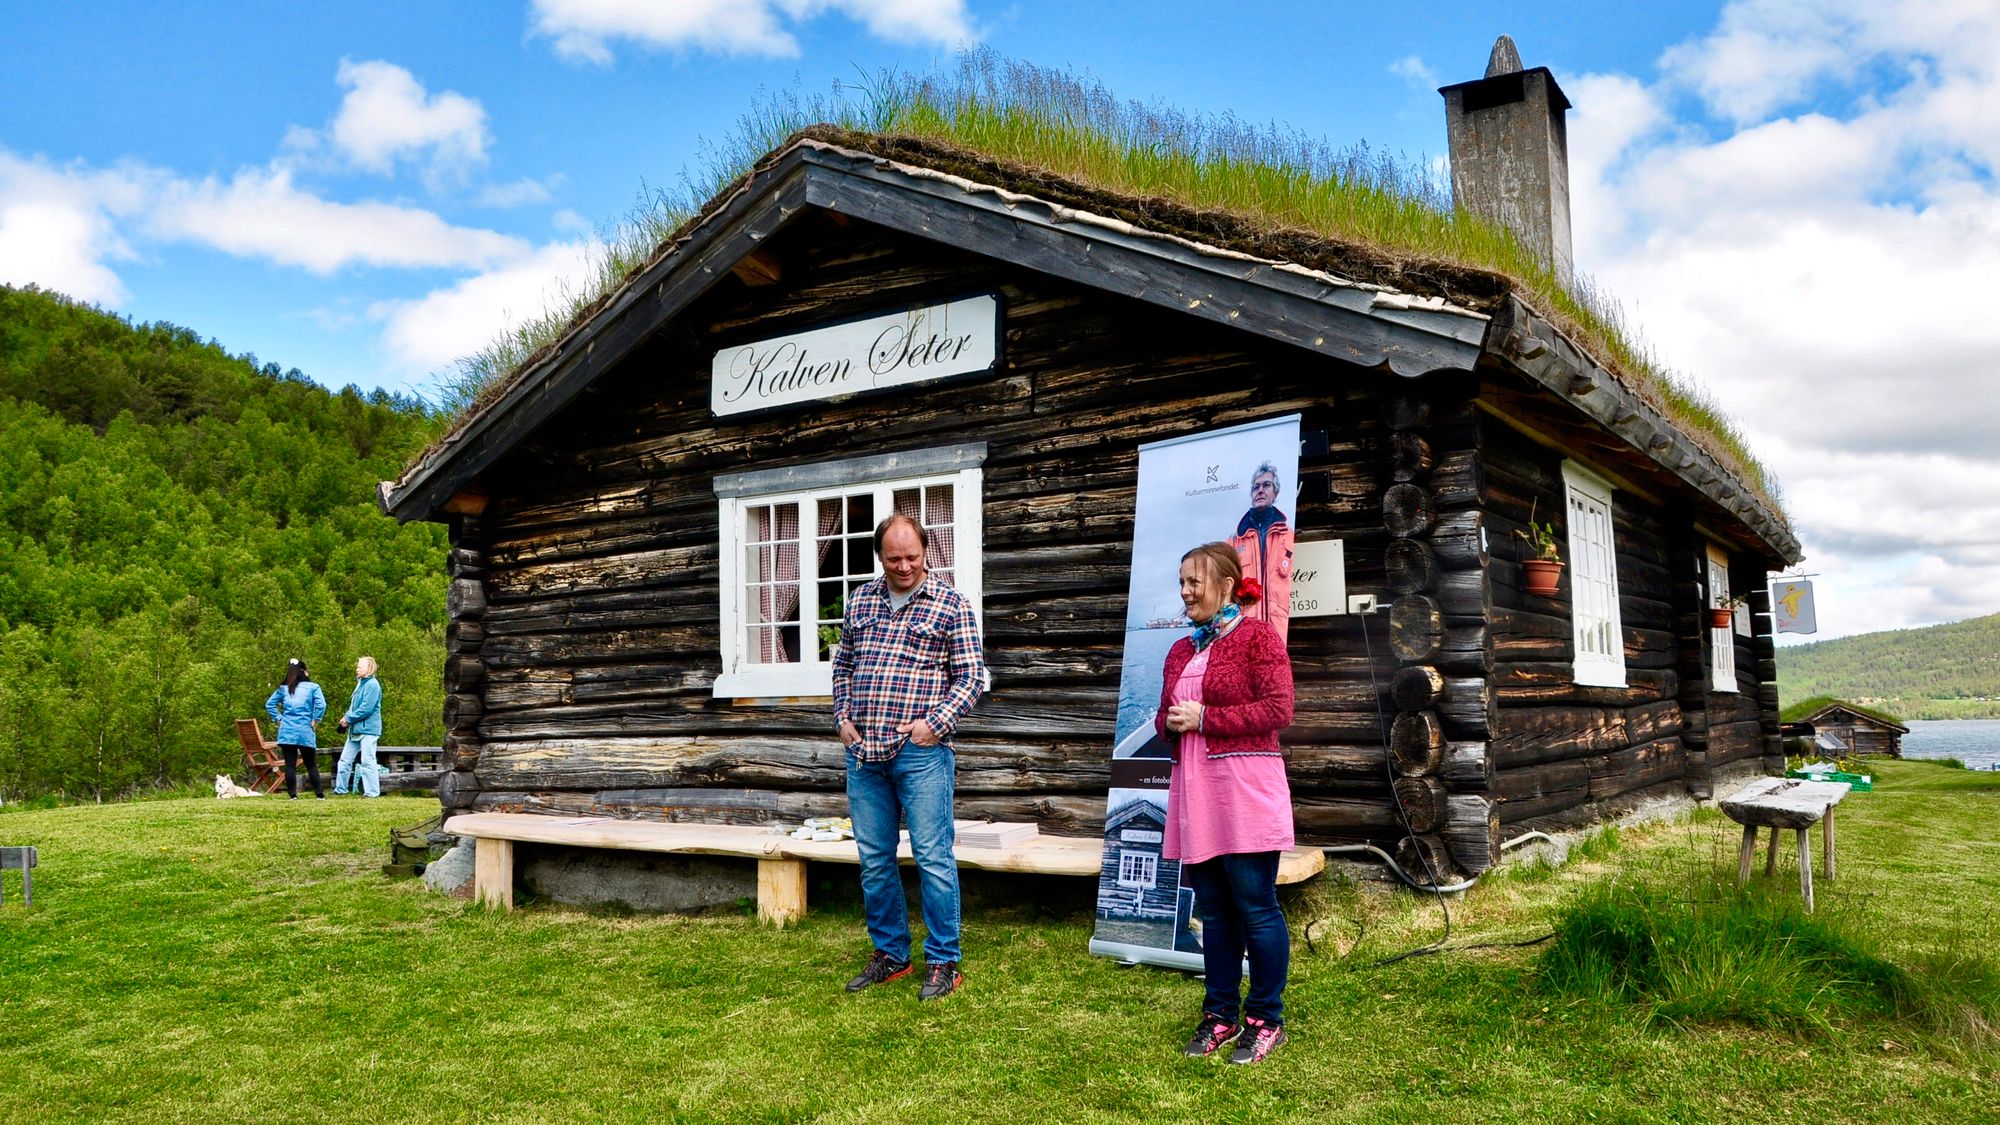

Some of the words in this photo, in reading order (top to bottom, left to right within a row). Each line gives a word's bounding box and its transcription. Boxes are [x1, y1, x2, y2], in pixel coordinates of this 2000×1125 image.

[723, 342, 854, 403] Kalven
[868, 313, 972, 388] Seter
[1185, 483, 1239, 497] Kulturminnefondet
